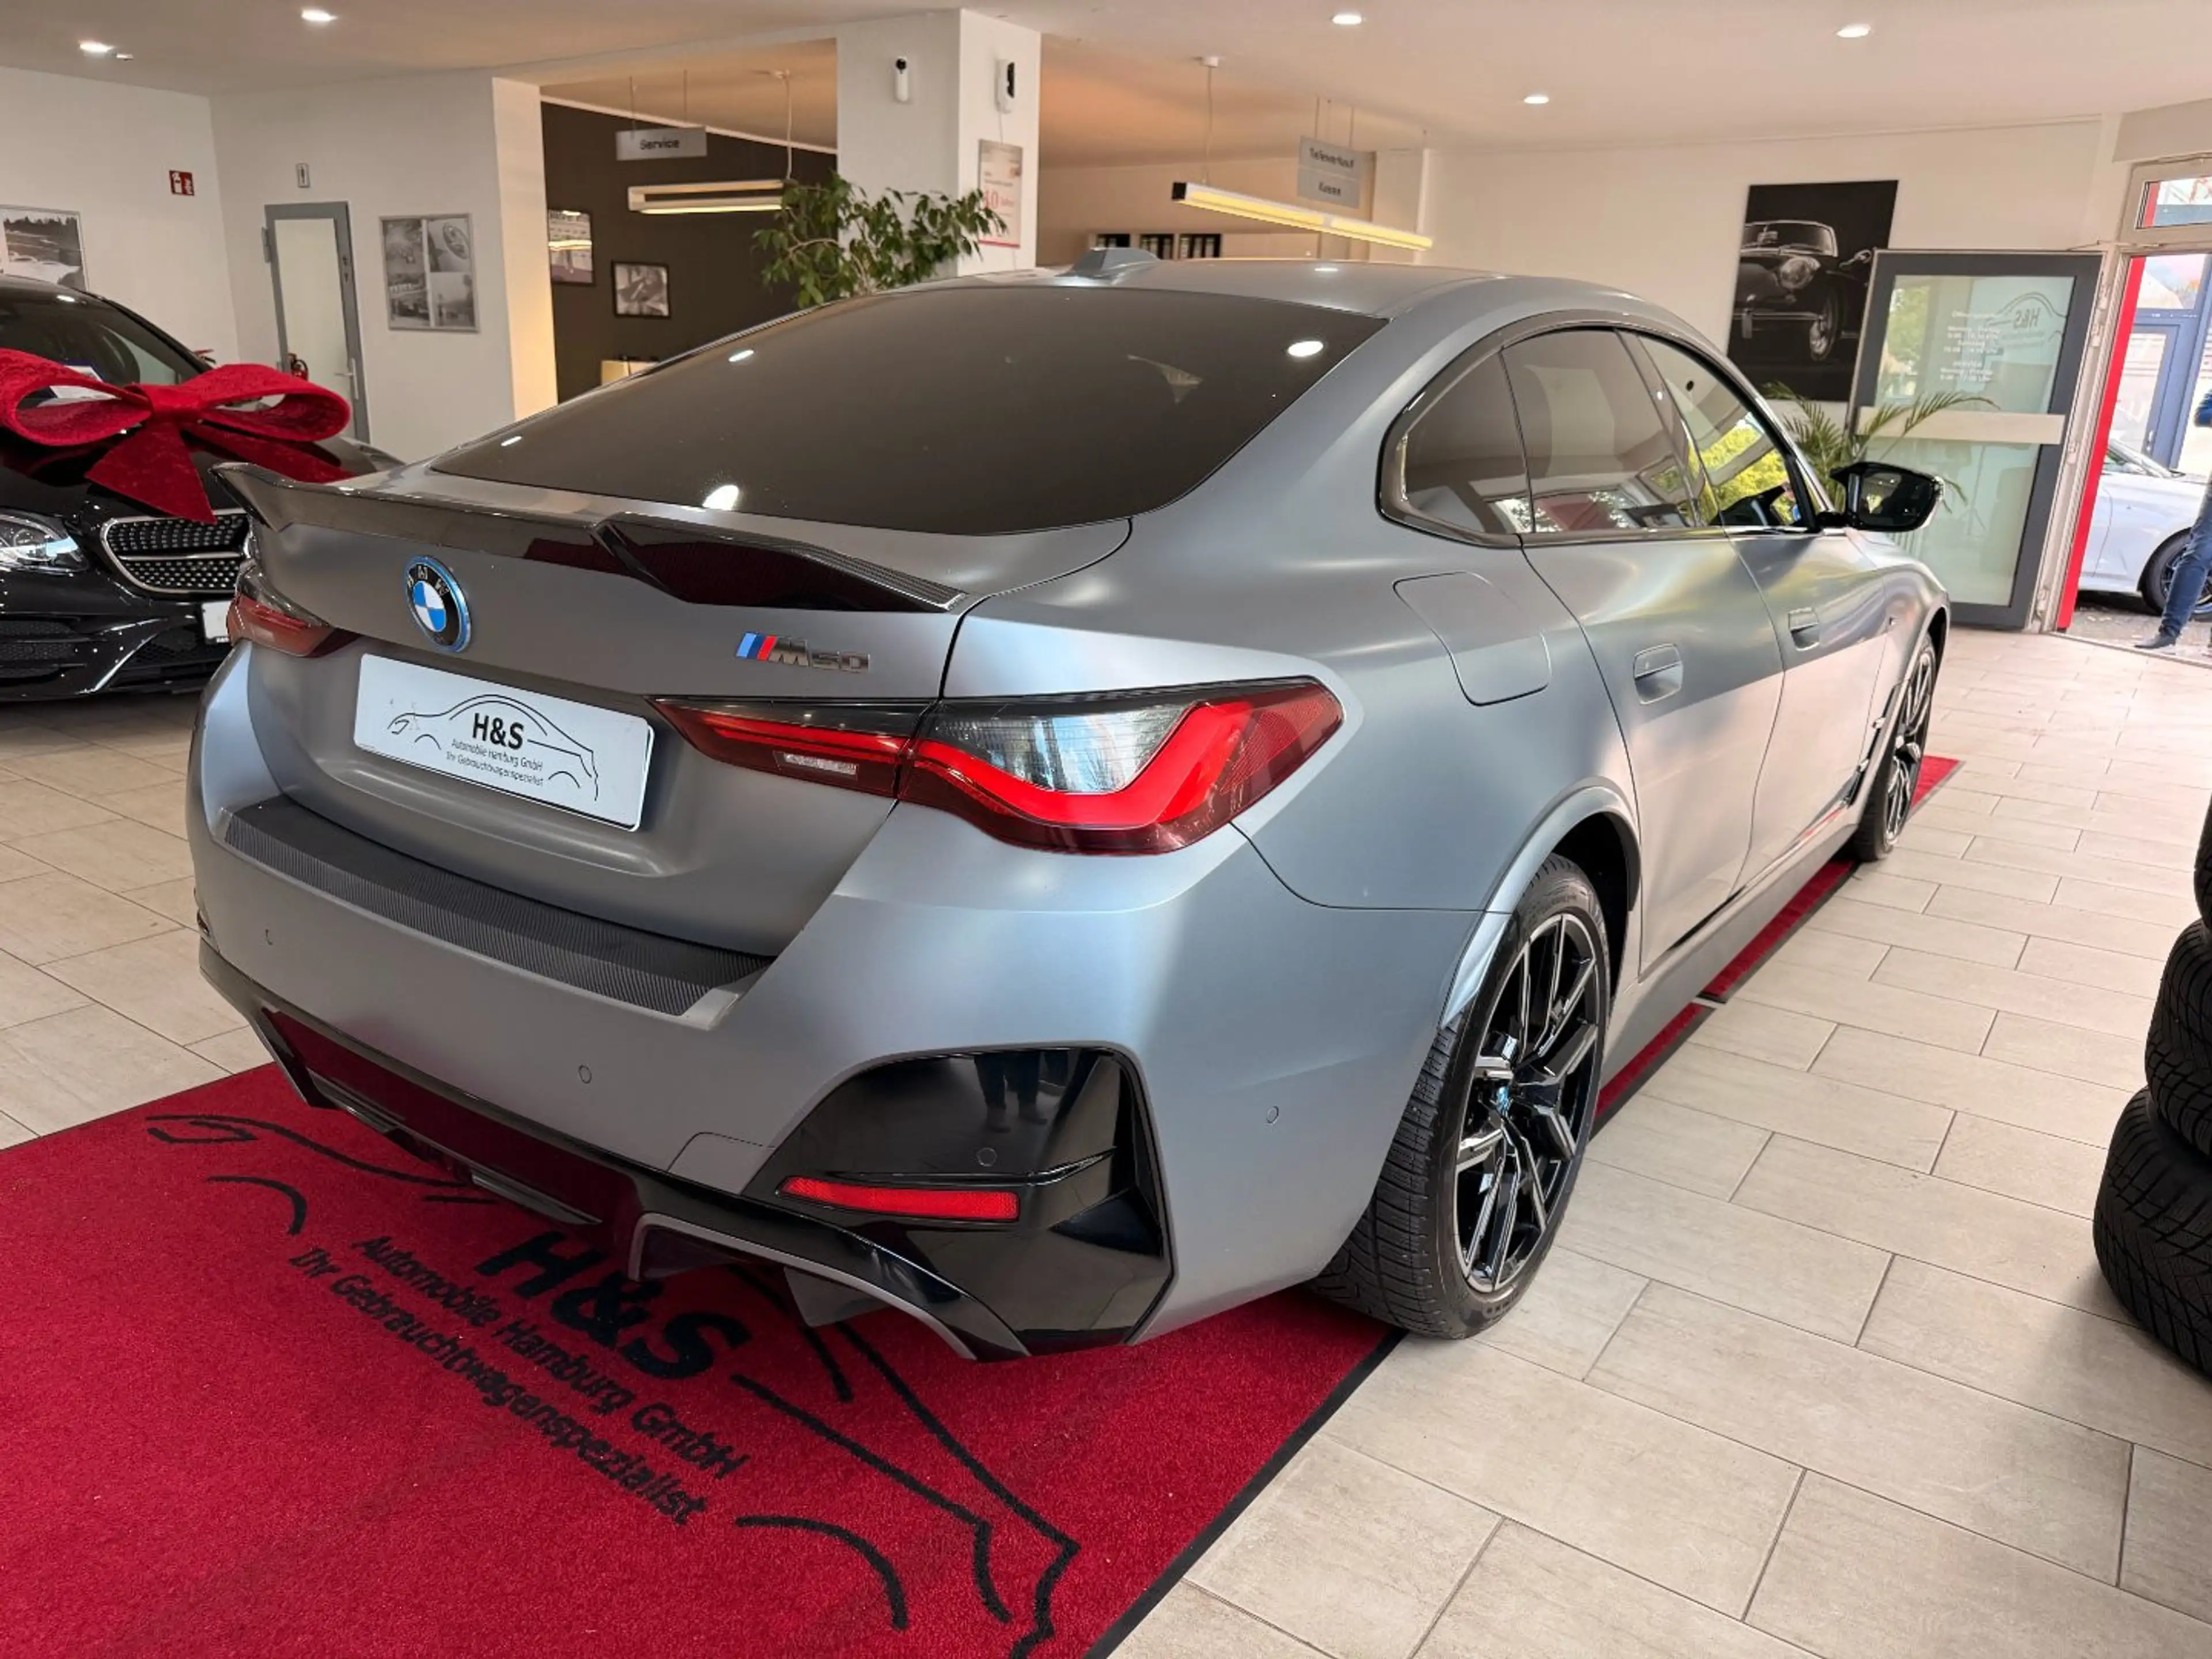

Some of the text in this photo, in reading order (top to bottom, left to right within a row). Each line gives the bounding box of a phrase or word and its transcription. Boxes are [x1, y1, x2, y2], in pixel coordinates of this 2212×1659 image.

[640, 138, 680, 150] Service
[407, 565, 450, 597] BMW
[766, 636, 871, 673] M50
[472, 713, 525, 749] H&S
[446, 751, 457, 762] Ihr
[452, 738, 544, 772] Automobile Hamburg GmbH
[474, 1231, 751, 1380] H&S
[350, 1236, 751, 1480] Automobile Hamburg GmbH
[289, 1247, 708, 1525] Ihr Gebrauchtwagenspezialist
